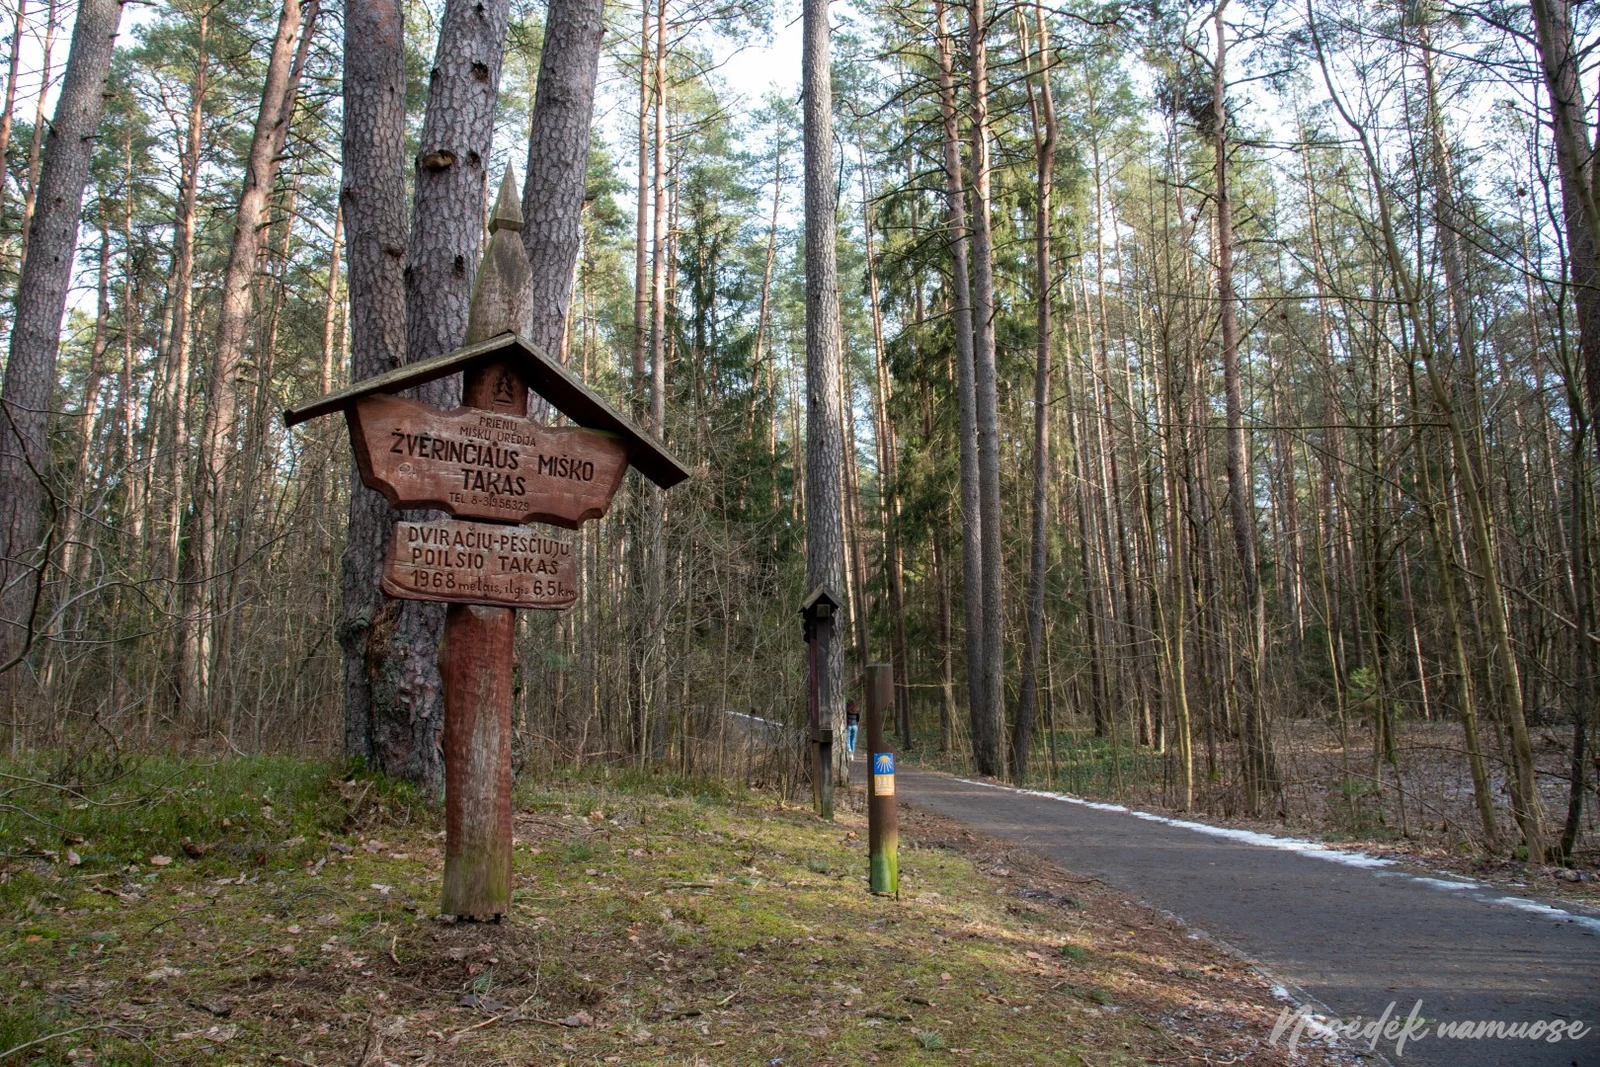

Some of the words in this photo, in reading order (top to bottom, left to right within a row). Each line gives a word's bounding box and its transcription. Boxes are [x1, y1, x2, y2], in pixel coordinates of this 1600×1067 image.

[389, 428, 519, 470] ŽVĖRINČIAUS
[538, 454, 595, 482] MIŠKO
[461, 468, 526, 497] TAKAS
[412, 548, 484, 570] POILSIO
[498, 555, 560, 576] TAKAS
[410, 569, 456, 589] 1968
[505, 579, 530, 599] ilgis
